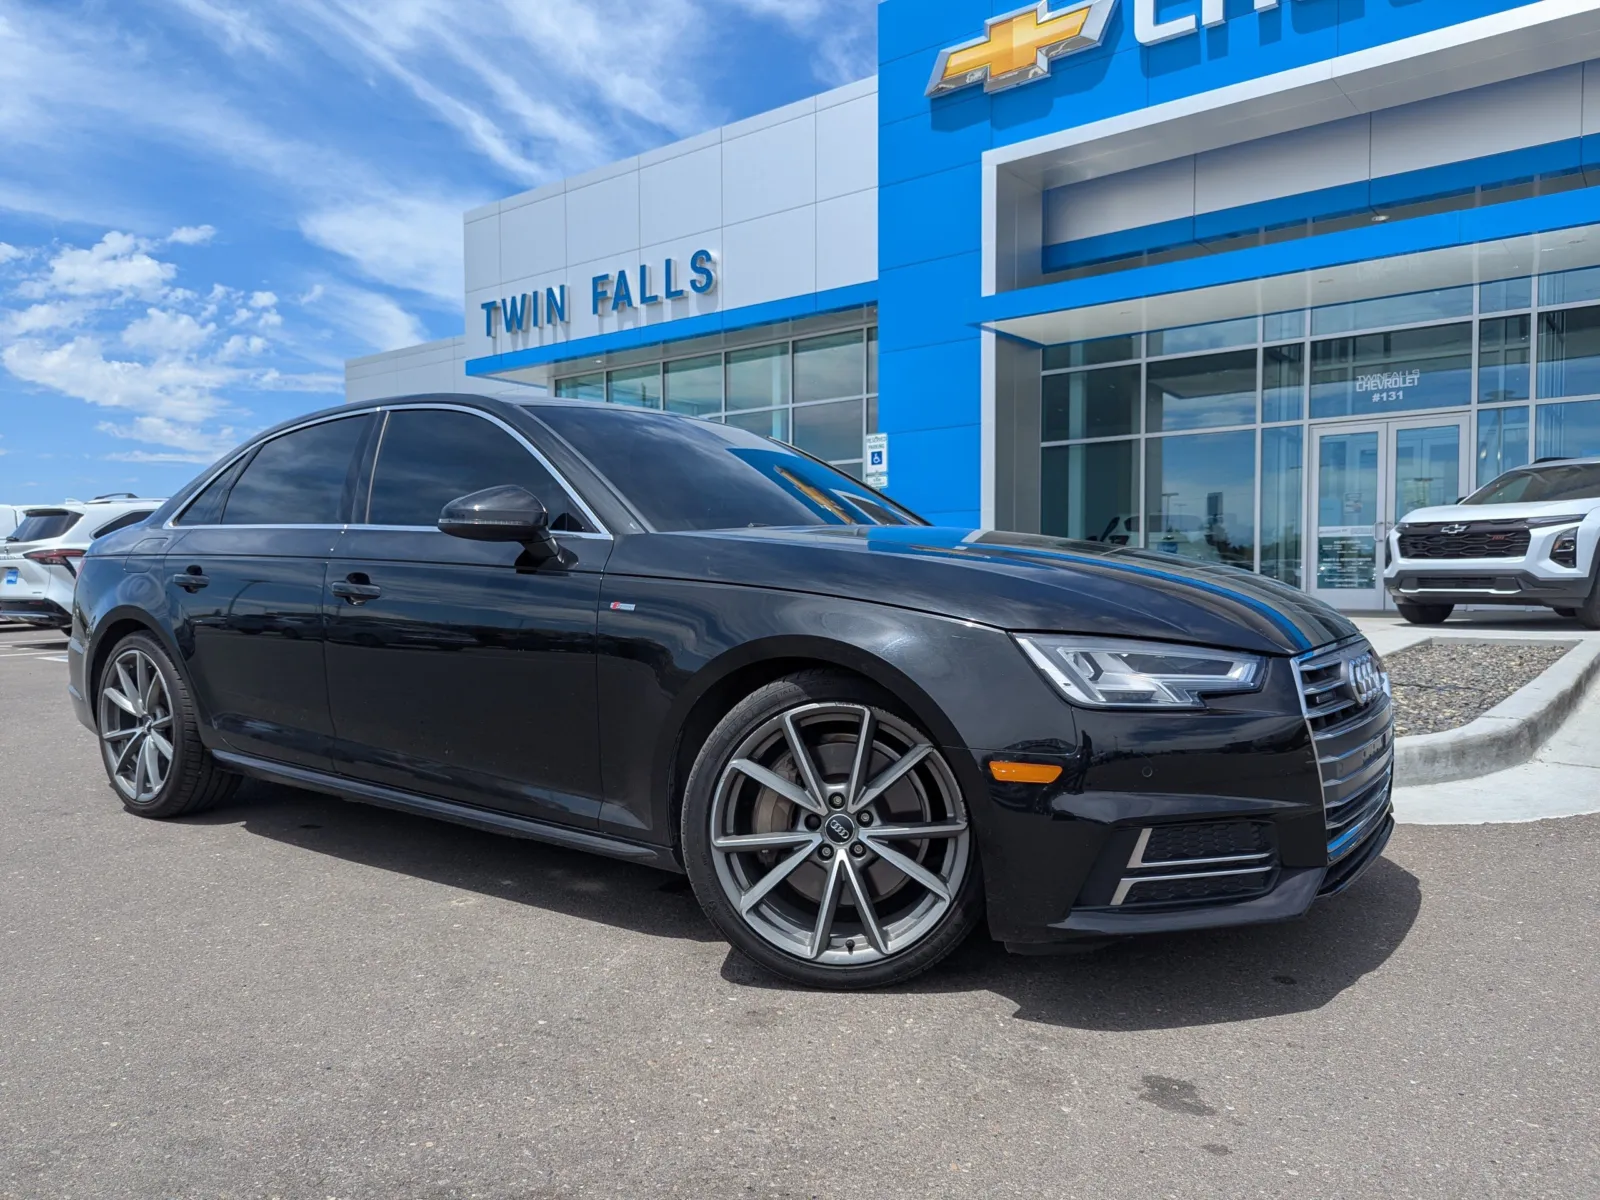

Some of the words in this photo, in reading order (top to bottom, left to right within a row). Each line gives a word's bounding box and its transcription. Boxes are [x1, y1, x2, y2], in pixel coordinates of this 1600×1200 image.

[481, 284, 568, 337] TWIN
[592, 249, 716, 316] FALLS
[1356, 376, 1419, 392] CHEVROLET
[1371, 390, 1404, 403] #131
